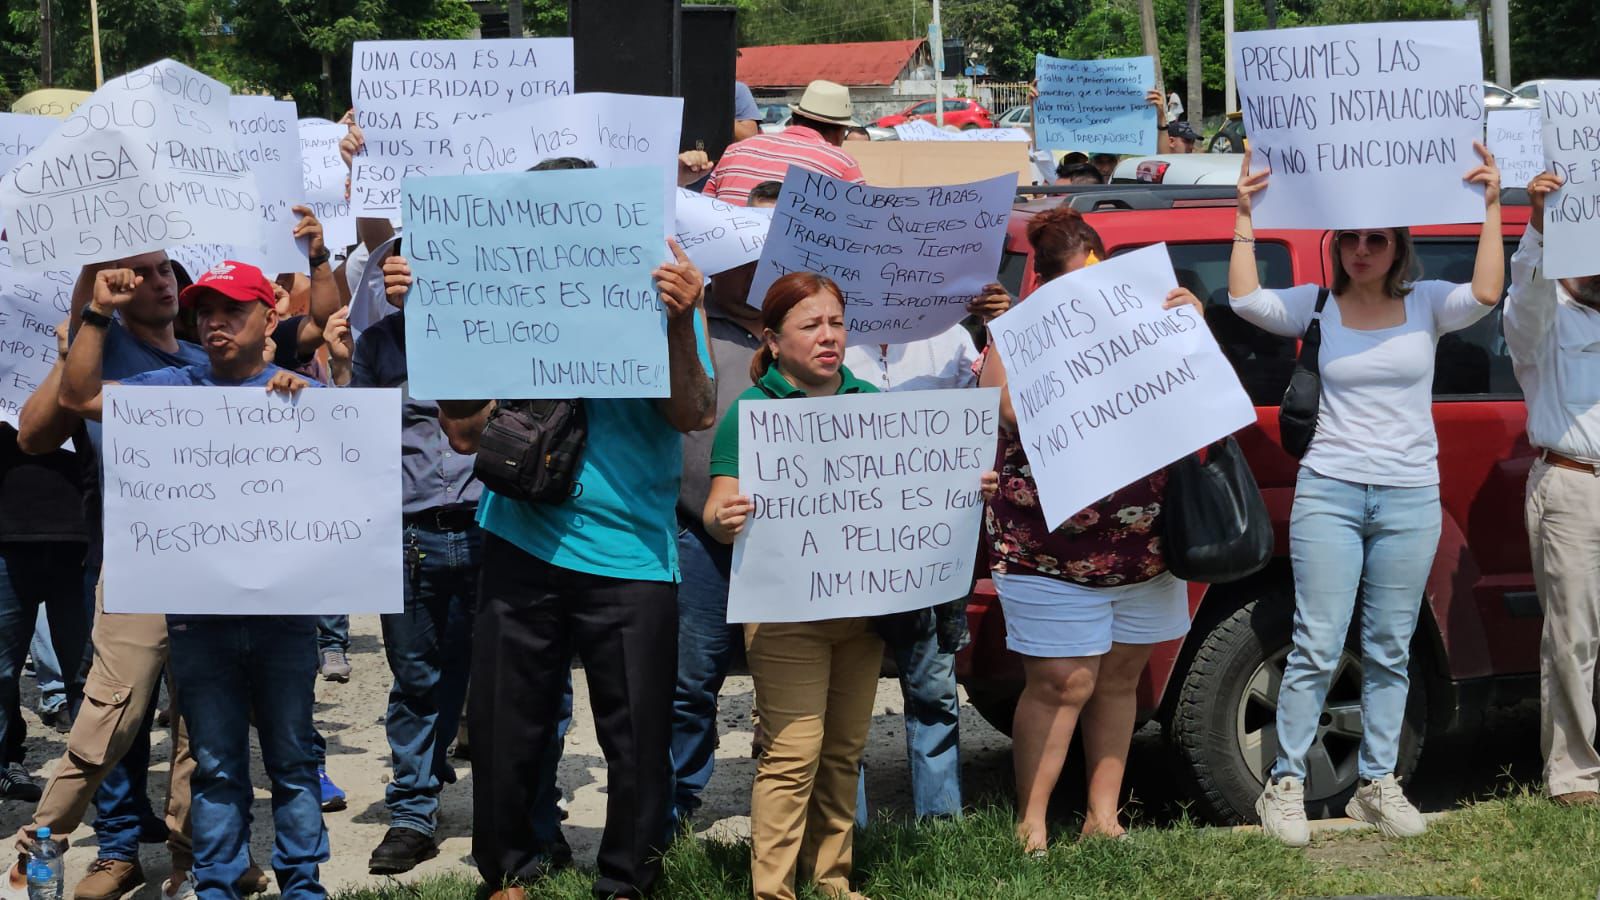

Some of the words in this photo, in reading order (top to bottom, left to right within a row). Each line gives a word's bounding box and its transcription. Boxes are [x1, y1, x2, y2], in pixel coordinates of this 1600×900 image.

[361, 51, 399, 71] UNA
[410, 51, 456, 70] COSA
[473, 50, 498, 69] ES
[509, 48, 537, 68] LA
[1242, 40, 1360, 82] PRESUMES
[1378, 38, 1421, 74] LAS
[357, 78, 499, 100] AUSTERIDAD
[520, 80, 570, 97] OTRA
[1543, 89, 1578, 119] NO
[62, 99, 156, 137] SOLO
[173, 103, 212, 134] ES
[229, 112, 287, 135] nsados
[358, 111, 402, 130] COSA
[414, 112, 439, 129] ES
[1247, 93, 1317, 132] NUEVAS
[1330, 84, 1482, 126] INSTALACIONES
[375, 140, 414, 157] TUS
[424, 139, 454, 158] TR
[531, 126, 578, 154] has
[597, 113, 650, 153] hecho
[146, 141, 159, 170] Y
[357, 164, 396, 182] ESO
[1258, 147, 1273, 175] Y
[1281, 145, 1306, 174] NO
[1317, 138, 1457, 172] FUNCIONAN
[803, 173, 837, 201] NO
[845, 182, 920, 208] CUBRES
[1552, 160, 1584, 188] DE
[16, 203, 54, 236] NO
[72, 190, 129, 224] HAS
[138, 181, 255, 211] CUMPLIDO
[356, 187, 401, 206] "EXP
[408, 193, 602, 229] MANTENIMIENTO
[615, 202, 649, 229] DE
[788, 191, 836, 223] PERO
[846, 213, 878, 231] SI
[887, 212, 967, 235] QUIERES
[974, 208, 1007, 230] QUE
[22, 236, 56, 265] EN
[73, 230, 103, 256] 5
[410, 232, 459, 265] LAS
[475, 244, 642, 273] INSTALACIONES
[778, 211, 903, 255] TRABAJEMOS
[913, 237, 983, 259] TIEMPO
[793, 245, 861, 281] EXTRA
[880, 262, 945, 287] GRATIS
[416, 276, 546, 308] DEFICIENTES
[560, 281, 591, 308] ES
[602, 284, 662, 312] IGUAL
[17, 308, 57, 338] TRAB
[426, 313, 441, 339] A
[463, 319, 559, 344] PELIGRO
[1002, 298, 1096, 374] PRESUMES
[1098, 283, 1142, 317] LAS
[0, 340, 35, 359] MPO
[1019, 370, 1065, 424] NUEVAS
[1064, 308, 1197, 385] INSTALACIONES
[215, 395, 315, 432] trabajo
[331, 404, 359, 421] en
[750, 408, 950, 445] MANTENIMIENTO
[964, 408, 993, 436] DE
[113, 438, 151, 468] las
[173, 439, 322, 467] instalaciones
[341, 442, 361, 463] lo
[1031, 434, 1046, 468] Y
[1047, 424, 1069, 457] NO
[756, 451, 808, 488] LAS
[823, 446, 983, 485] INSTALACIONES
[119, 477, 216, 500] hacemos
[241, 478, 284, 496] con
[751, 486, 883, 520] DEFICIENTES
[902, 486, 933, 511] ES
[801, 529, 818, 557] A
[842, 522, 952, 553] PELIGRO
